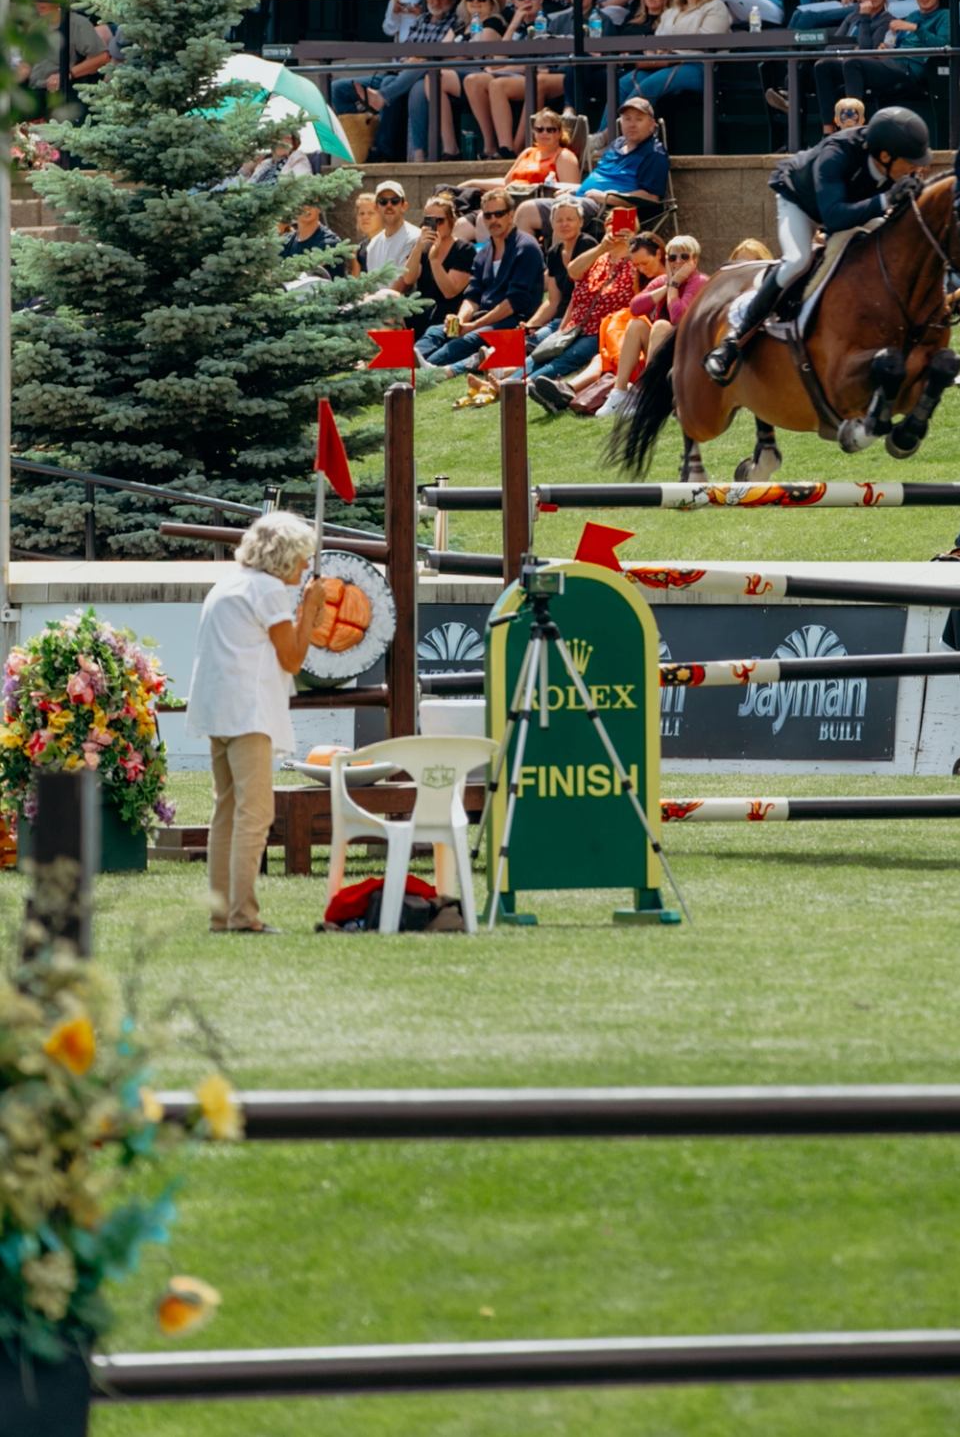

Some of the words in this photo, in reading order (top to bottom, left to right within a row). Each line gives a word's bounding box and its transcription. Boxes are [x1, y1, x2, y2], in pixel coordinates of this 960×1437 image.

[518, 684, 638, 711] ROLEX
[738, 678, 868, 735] Jayman
[817, 721, 865, 741] BUILT
[516, 764, 638, 798] FINISH
